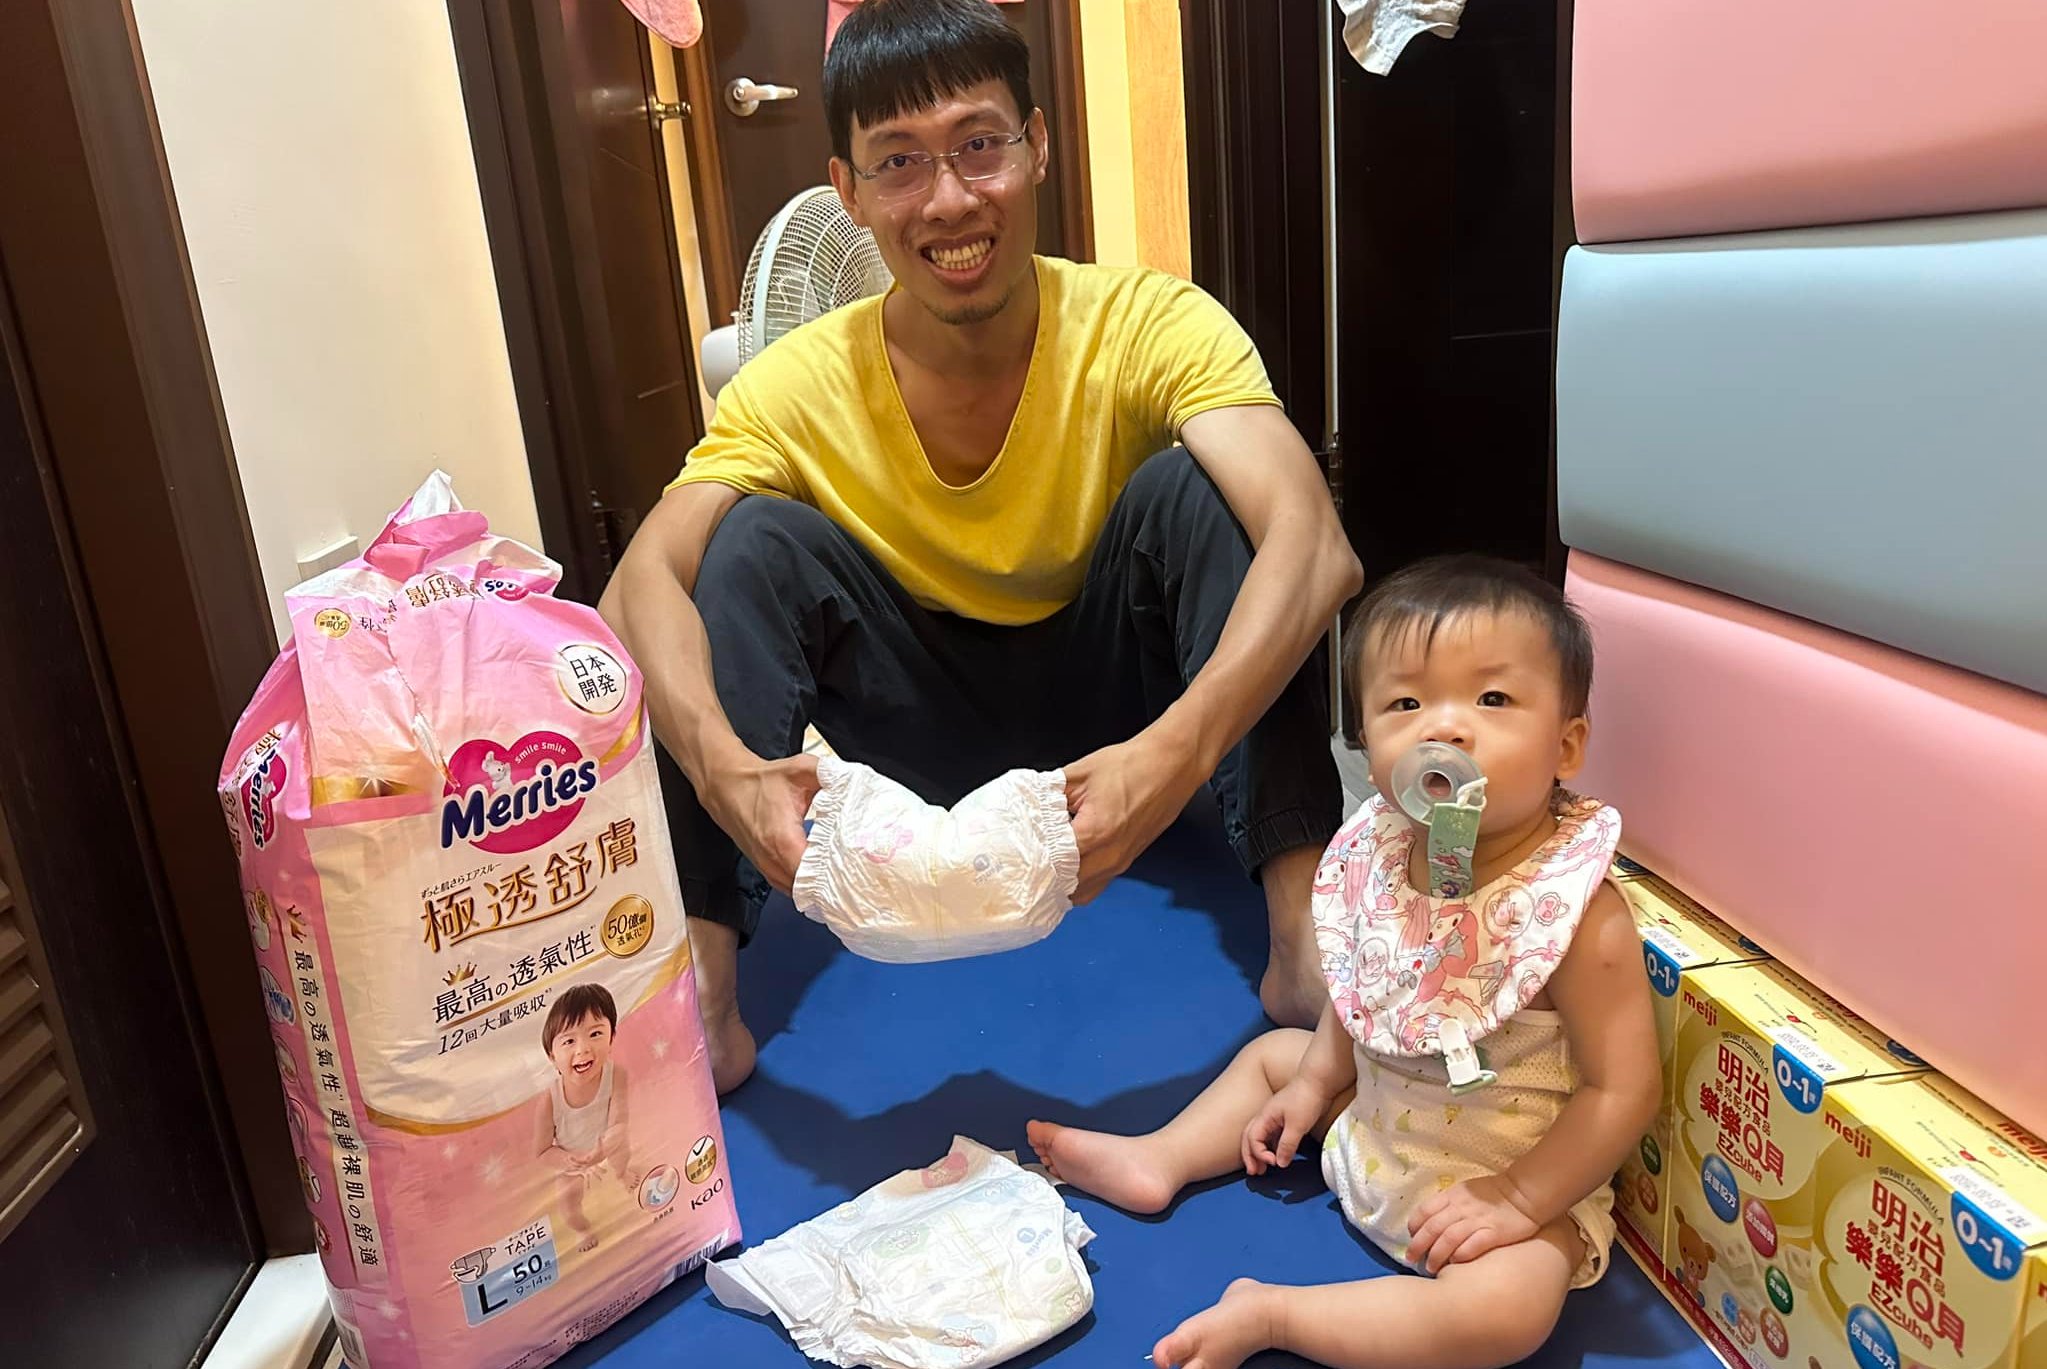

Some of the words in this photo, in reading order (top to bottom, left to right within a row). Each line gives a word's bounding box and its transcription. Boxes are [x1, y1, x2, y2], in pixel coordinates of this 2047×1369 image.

[569, 655, 606, 678] 日本
[578, 673, 617, 702] 開発
[515, 741, 539, 764] smile
[541, 741, 568, 755] smile
[252, 749, 276, 849] Merries
[441, 759, 597, 849] Merries
[420, 816, 640, 954] 極透舒膚
[1683, 989, 1718, 1026] meiji
[1718, 1043, 1770, 1119] 明治
[1824, 1110, 1872, 1158] meiji
[1905, 1175, 1945, 1226] FORMULA
[504, 1226, 547, 1256] TAPE
[1872, 1179, 1946, 1277] 明治
[512, 1253, 543, 1285] 50
[477, 1283, 509, 1315] L
[1870, 1281, 1934, 1350] EZcube
